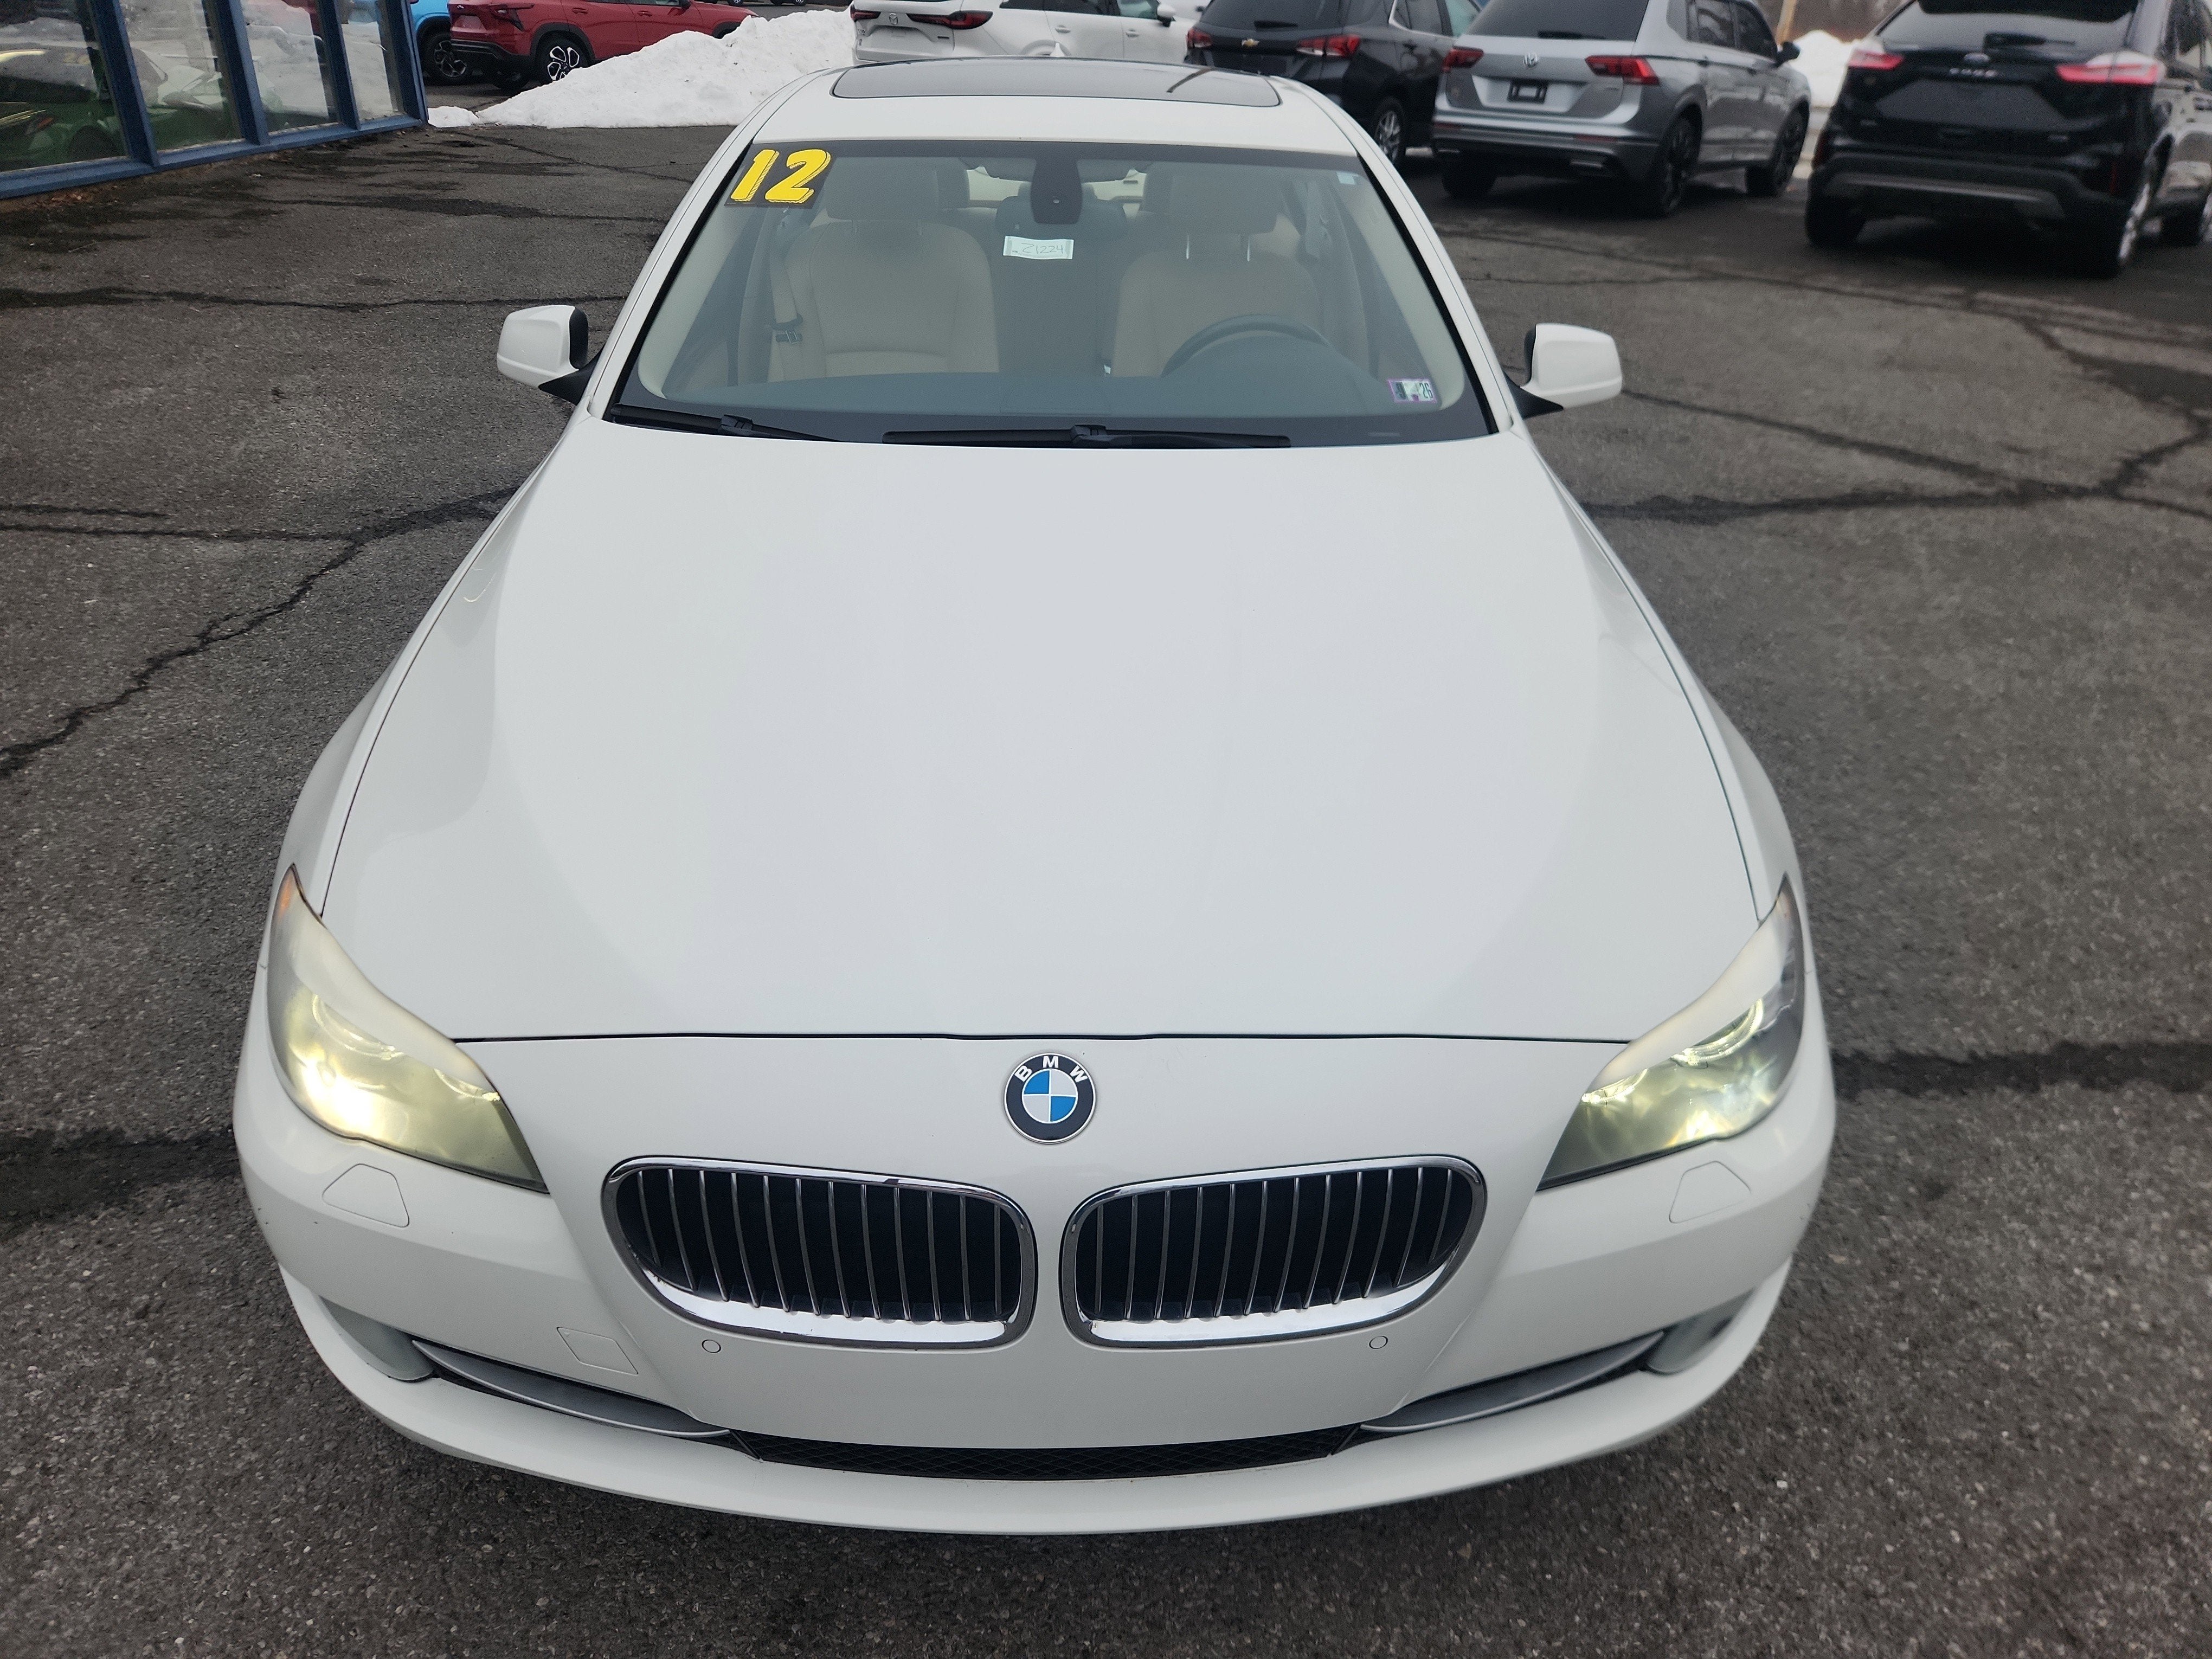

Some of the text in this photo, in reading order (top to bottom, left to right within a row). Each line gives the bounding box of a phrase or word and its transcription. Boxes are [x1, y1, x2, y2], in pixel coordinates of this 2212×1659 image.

[730, 149, 831, 203] 12
[1419, 382, 1433, 398] 26
[1014, 1056, 1088, 1083] BMW
